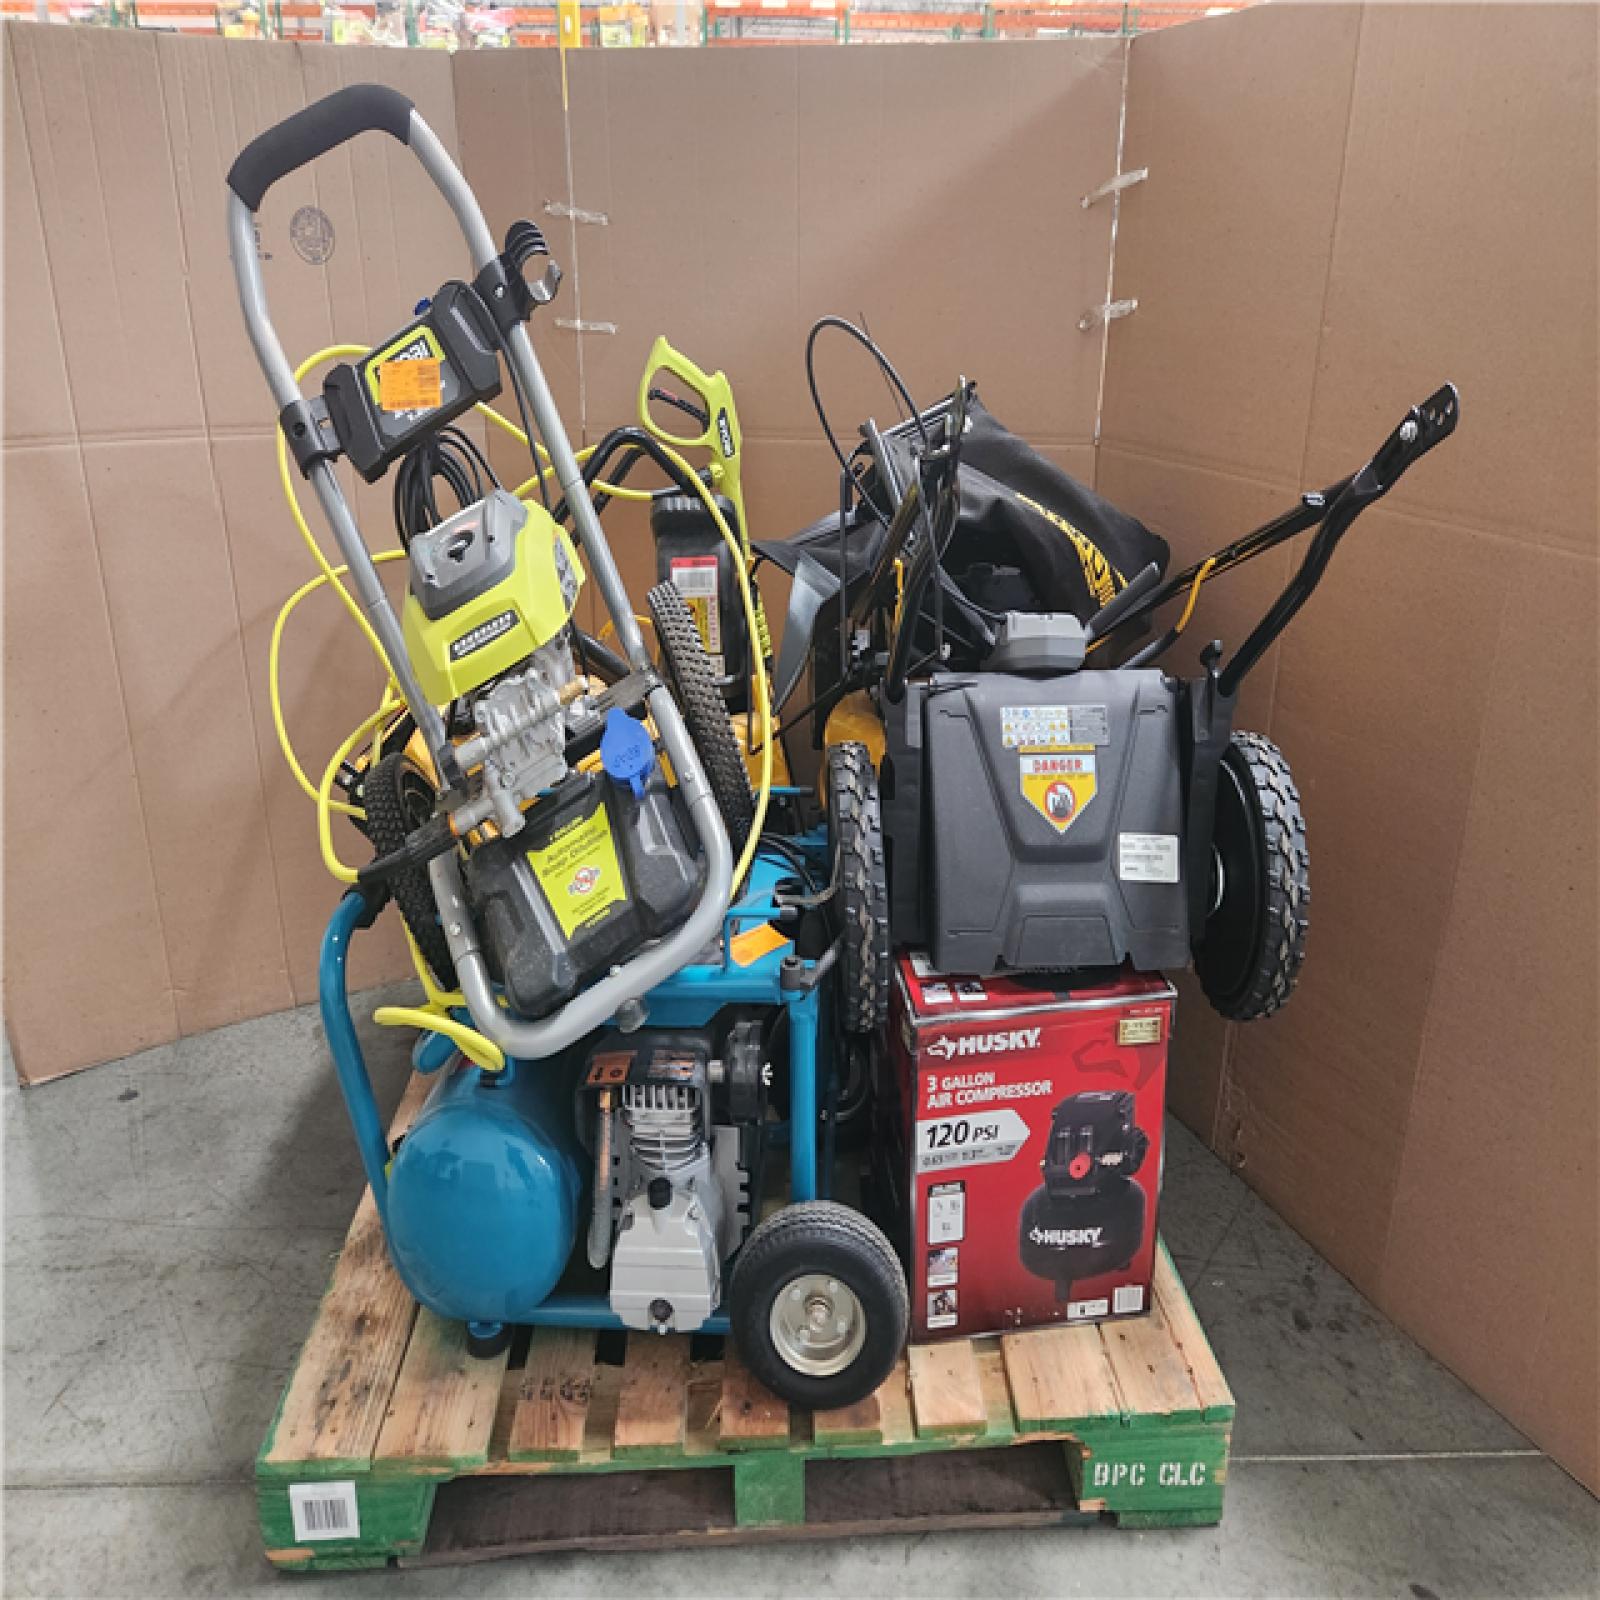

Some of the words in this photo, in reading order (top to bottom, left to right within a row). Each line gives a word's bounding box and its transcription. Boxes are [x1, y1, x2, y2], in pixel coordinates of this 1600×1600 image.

[1033, 759, 1083, 773] DANGER
[958, 1027, 1041, 1056] HUSKY
[927, 1074, 937, 1093] 3
[942, 1072, 995, 1091] GALLON
[927, 1091, 953, 1109] AIR
[955, 1080, 1053, 1105] COMPRESSOR
[927, 1120, 970, 1149] 120
[972, 1125, 999, 1142] PSI
[1044, 1226, 1104, 1245] HUSKY
[1094, 1462, 1146, 1486] BPC
[1159, 1462, 1206, 1486] CLC
